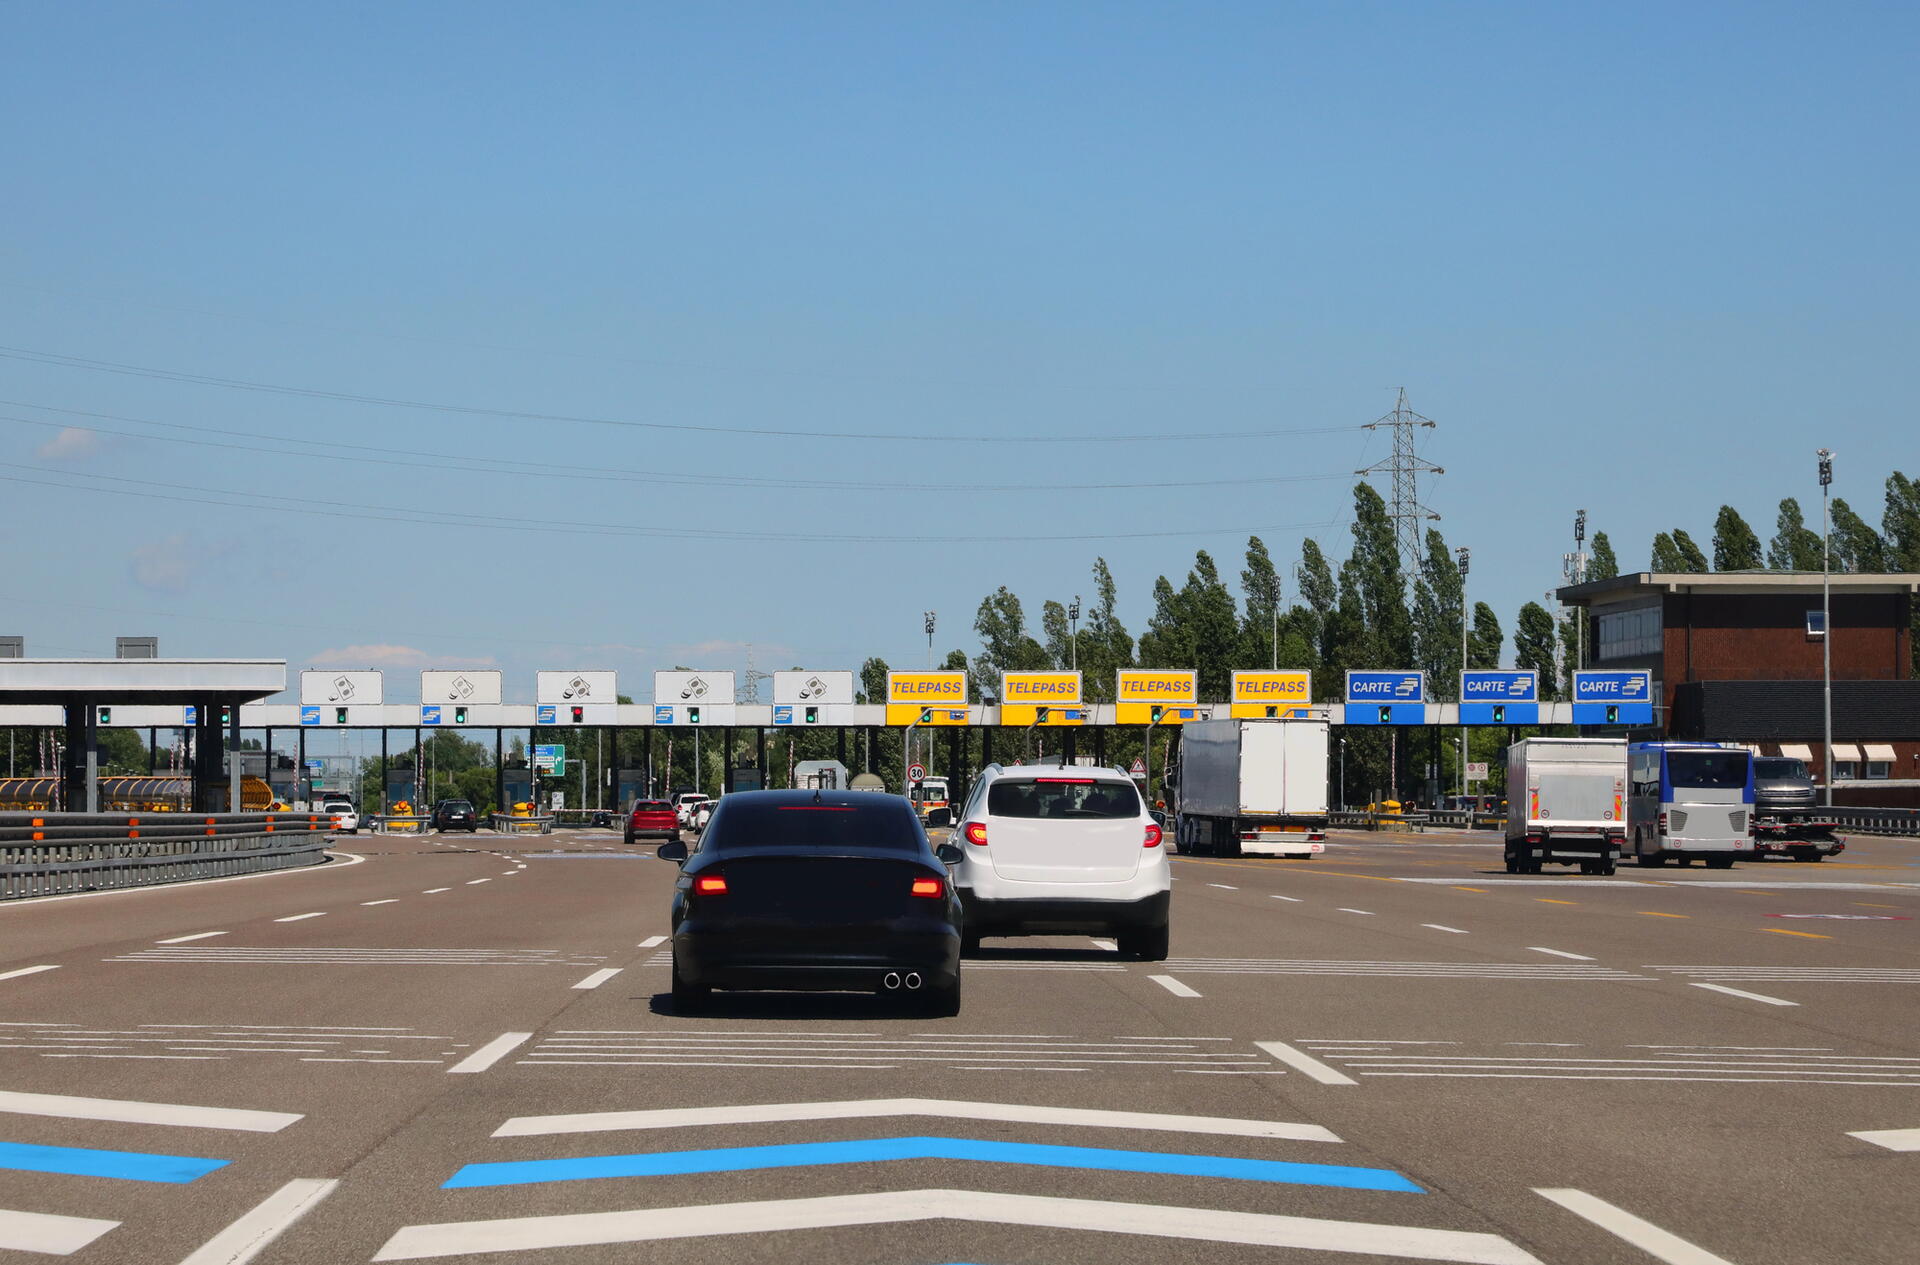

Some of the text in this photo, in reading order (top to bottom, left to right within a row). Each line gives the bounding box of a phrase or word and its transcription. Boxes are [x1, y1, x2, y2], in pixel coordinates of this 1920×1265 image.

[893, 681, 962, 694] TELEPASS
[1007, 681, 1076, 694] TELEPASS
[1122, 680, 1191, 693] TELEPASS
[1237, 681, 1306, 693] TELEPASS
[1352, 681, 1392, 693] CARTE
[1466, 680, 1506, 692] CARTE
[1579, 681, 1619, 692] CARTE
[911, 768, 923, 778] 30
